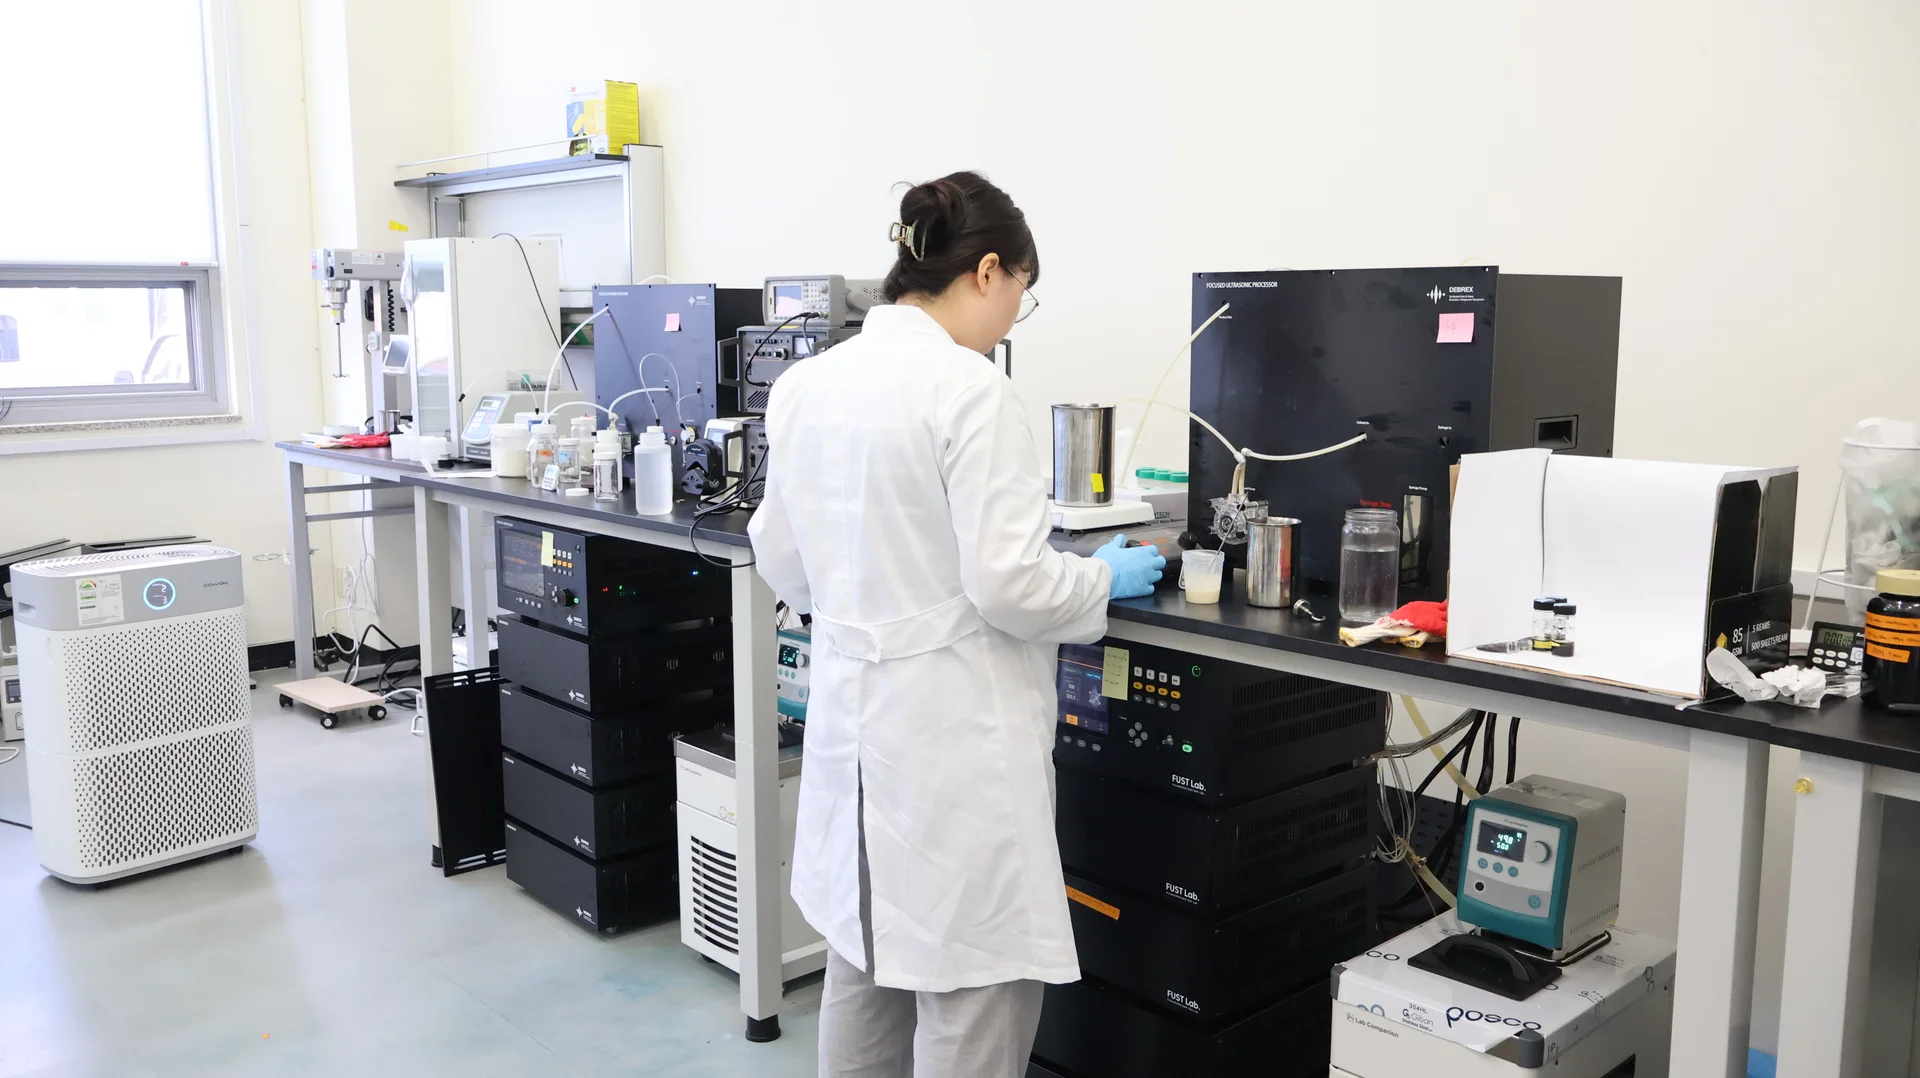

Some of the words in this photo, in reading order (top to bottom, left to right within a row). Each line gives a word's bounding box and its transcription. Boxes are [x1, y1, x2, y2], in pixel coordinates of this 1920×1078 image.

[1732, 627, 1743, 643] 85
[1752, 624, 1756, 633] 5
[1756, 620, 1771, 632] REAMS
[1732, 646, 1743, 656] GSM
[1751, 640, 1760, 651] 500
[1760, 633, 1788, 649] SHEETS/REAM
[1172, 774, 1190, 786] FUST
[1190, 779, 1207, 791] Lab.
[1165, 882, 1183, 895] FUST
[1184, 889, 1200, 902] Lab.
[1167, 989, 1185, 1003] FUST
[1185, 997, 1201, 1011] Lab.
[1446, 1006, 1542, 1029] posco
[1355, 1017, 1366, 1027] Lab
[1366, 1021, 1399, 1038] Companion
